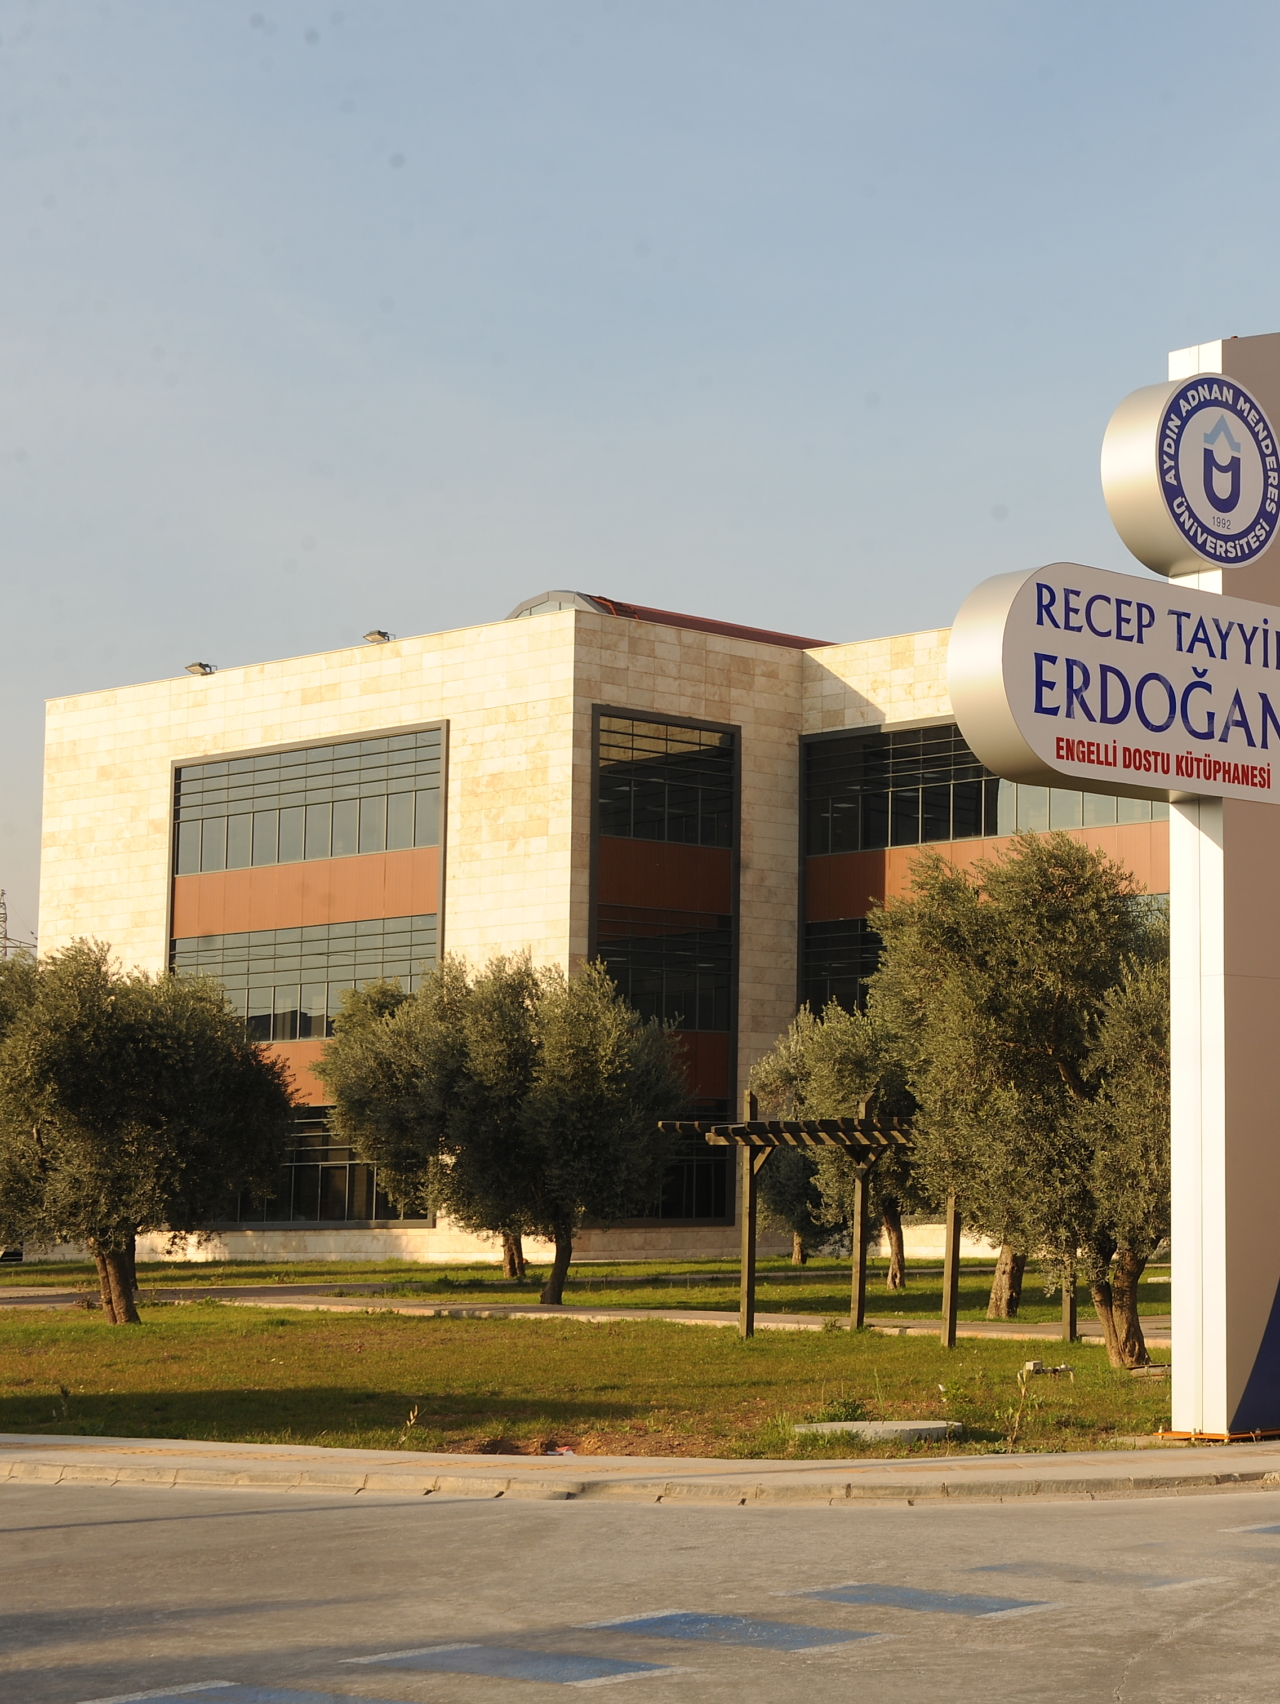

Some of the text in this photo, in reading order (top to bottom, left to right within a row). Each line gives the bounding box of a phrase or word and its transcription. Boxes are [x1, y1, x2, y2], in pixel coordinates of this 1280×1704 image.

[1163, 383, 1279, 516] AYDIN ADNAN MENDERES
[1173, 496, 1271, 558] ÜNİVERSİTESİ
[1212, 515, 1232, 531] 1992
[1035, 582, 1156, 645] RECEP
[1055, 736, 1272, 789] ENGELLİ DOSTU KÜTÜPHANESİ
